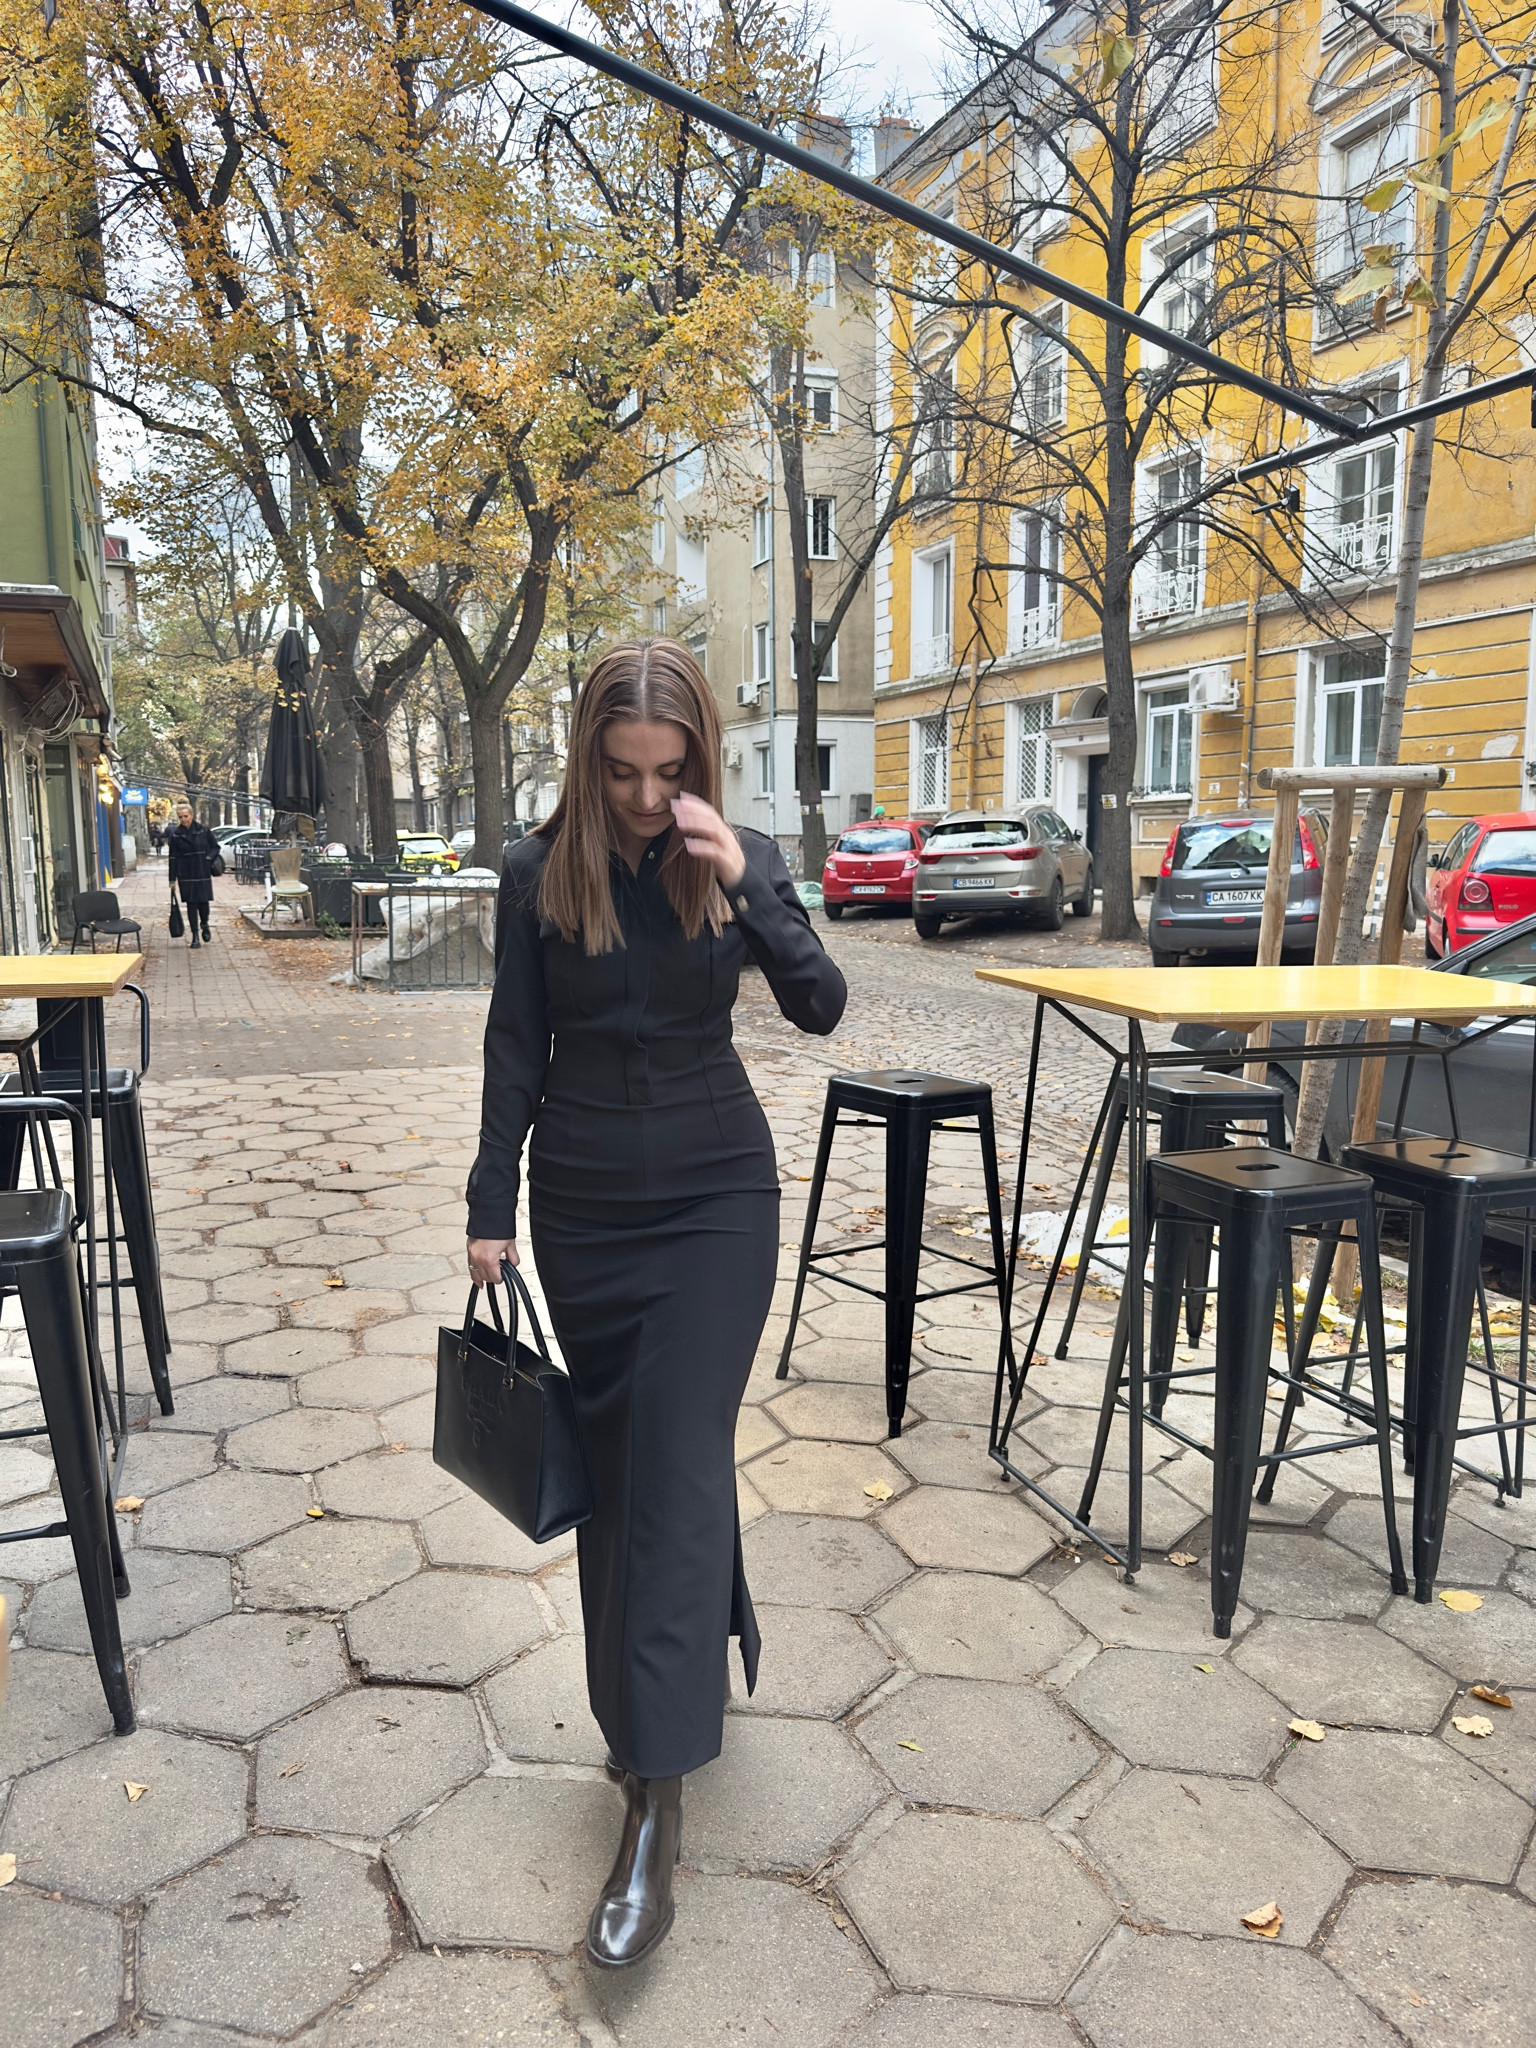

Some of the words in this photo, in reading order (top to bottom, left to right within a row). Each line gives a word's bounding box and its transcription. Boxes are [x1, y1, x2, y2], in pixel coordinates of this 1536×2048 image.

[1212, 892, 1225, 902] CA
[1228, 891, 1249, 901] 1607
[1250, 891, 1263, 900] KK
